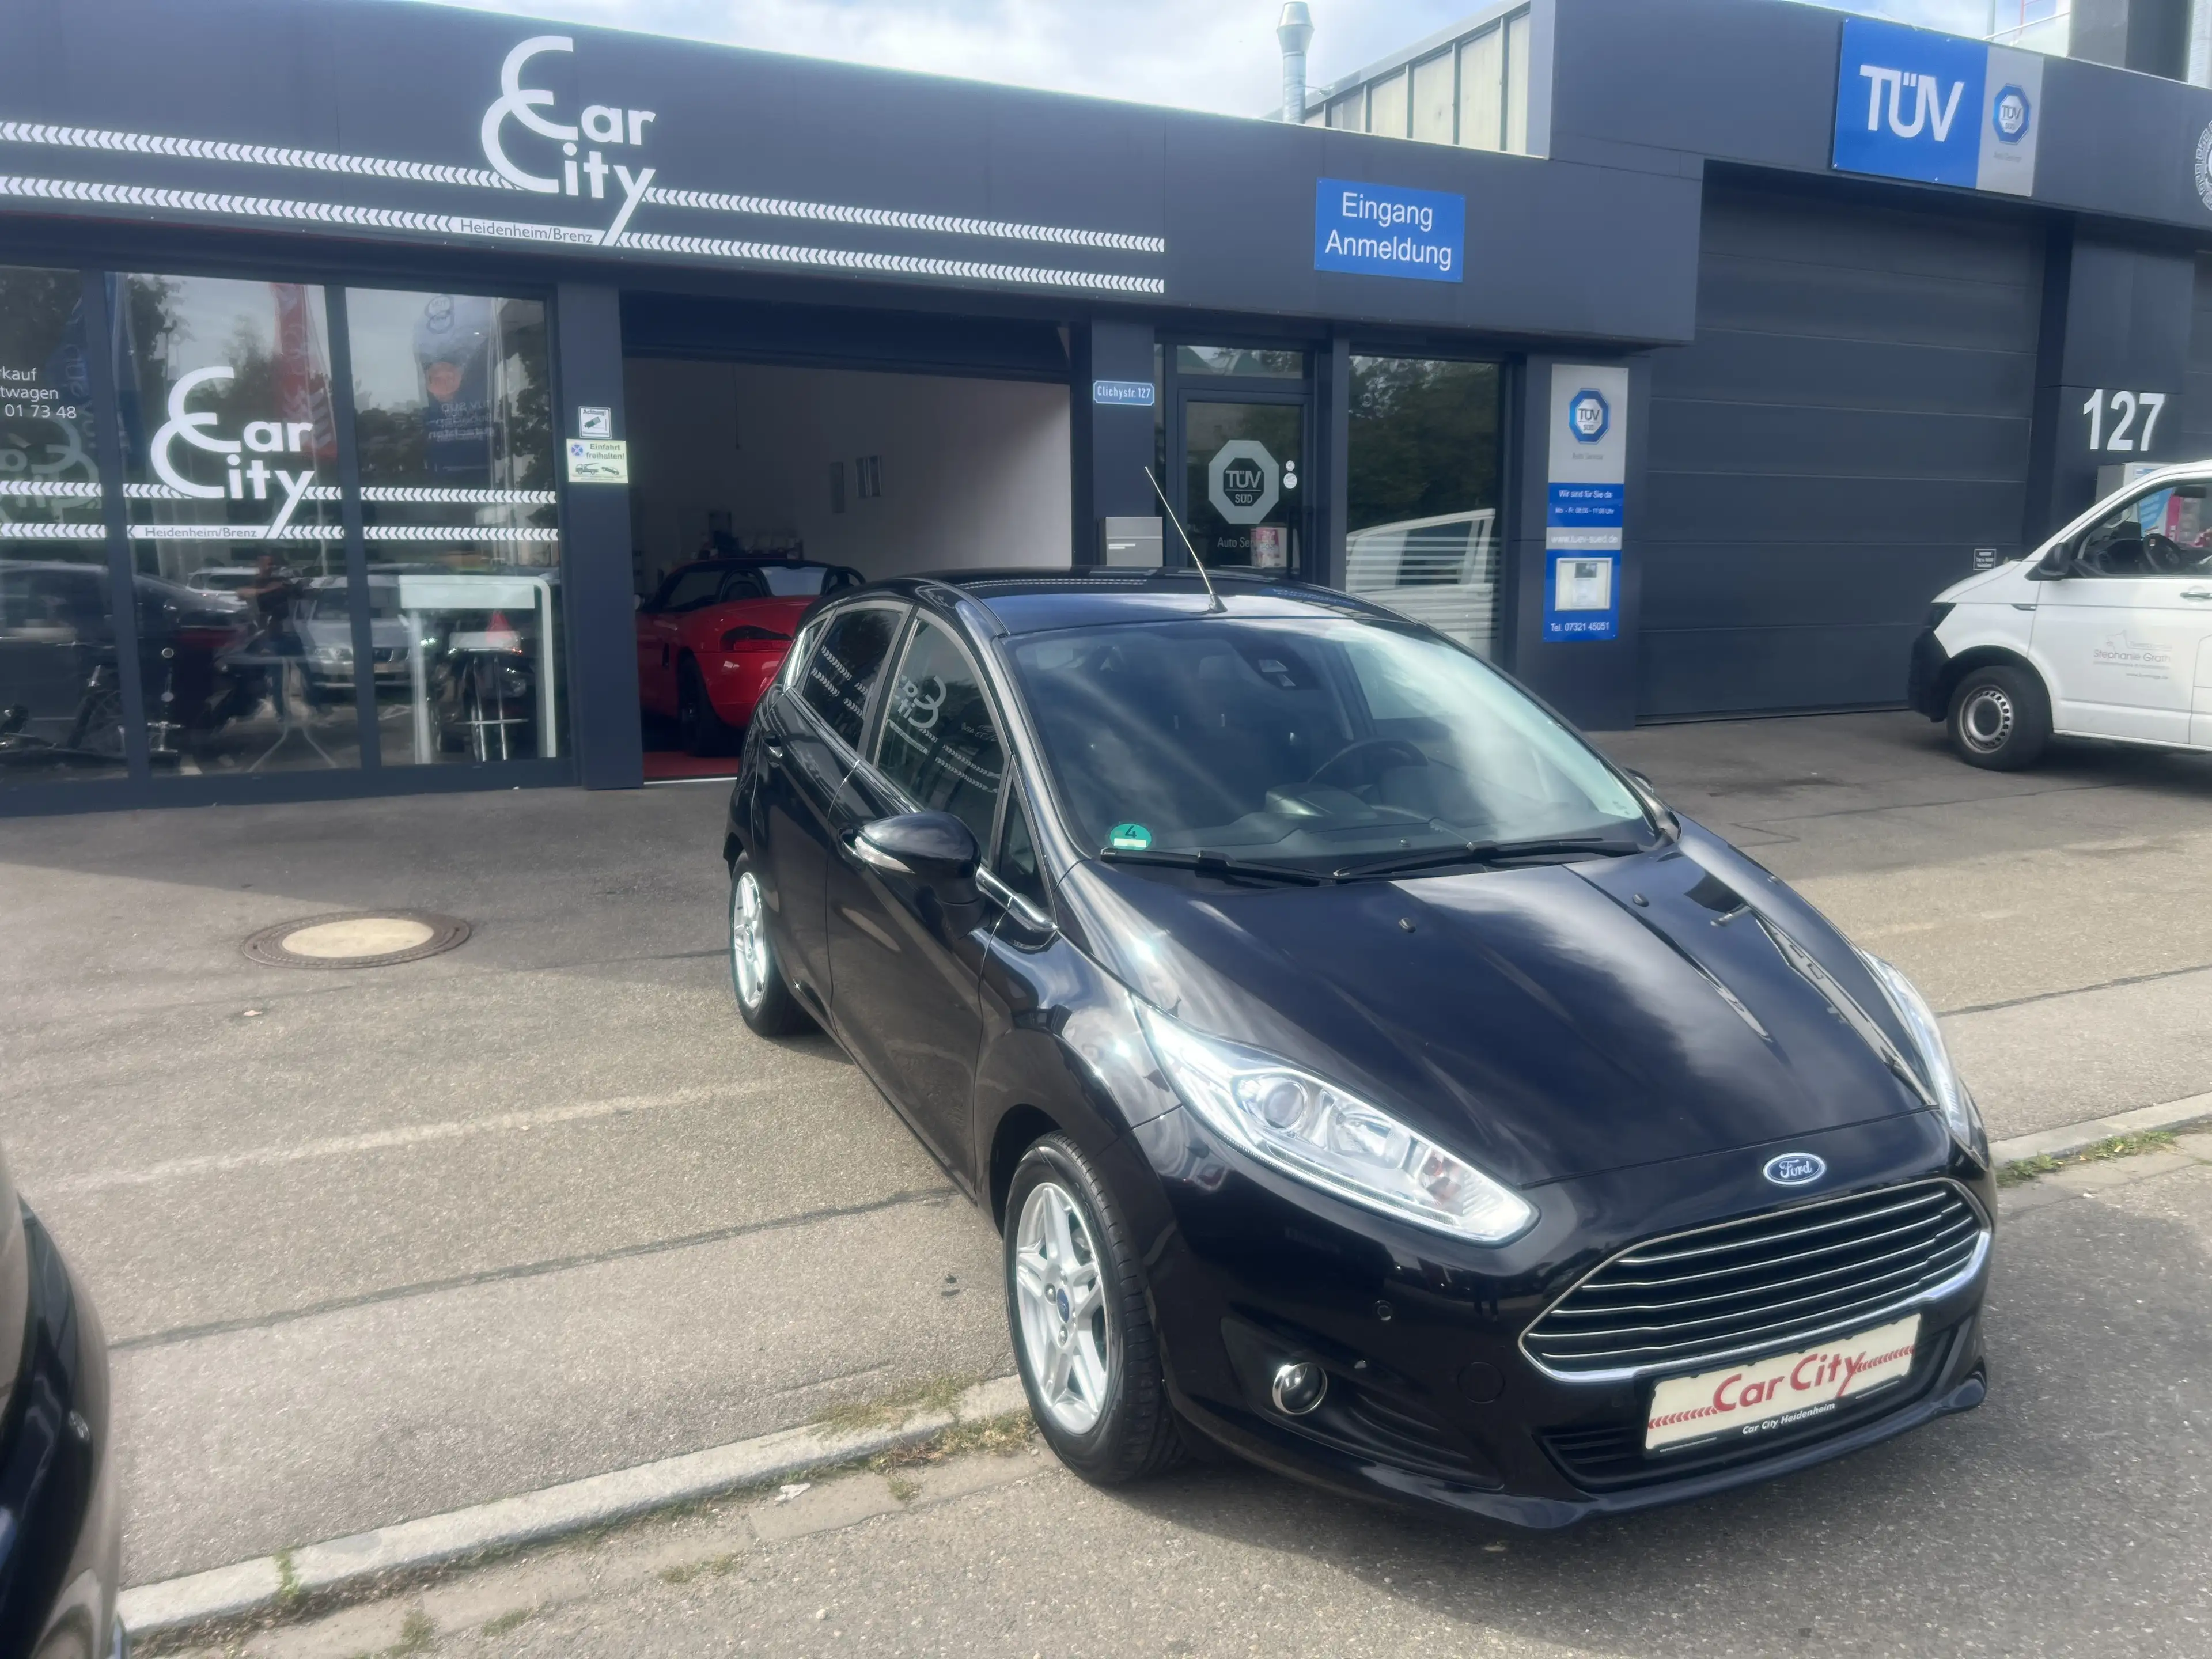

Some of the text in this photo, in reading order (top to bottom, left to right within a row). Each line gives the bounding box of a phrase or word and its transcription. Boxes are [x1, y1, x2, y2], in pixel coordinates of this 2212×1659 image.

[501, 35, 656, 145] Car
[1859, 64, 1965, 142] TÜV
[481, 94, 656, 246] City
[1342, 192, 1433, 232] Eingang
[460, 219, 593, 244] Heidenheim/Brenz
[1325, 229, 1452, 271] Anmeldung
[1097, 385, 1151, 400] Clichystr. 127
[5, 403, 77, 419] 01 73 48
[168, 366, 313, 453] Car
[2083, 389, 2165, 452] 127
[590, 443, 620, 451] Einfahrt
[150, 419, 315, 539] City
[1225, 470, 1262, 488] TÜV
[145, 527, 257, 538] Heidenheim/Brenz
[1217, 537, 1237, 548] Auto
[1564, 623, 1586, 631] 07321
[1588, 622, 1610, 631] 45051
[1124, 825, 1137, 838] 4
[1779, 1159, 1813, 1178] Ford
[1713, 1351, 1866, 1411] Car City
[1742, 1402, 1835, 1435] Car City Heidenheim
